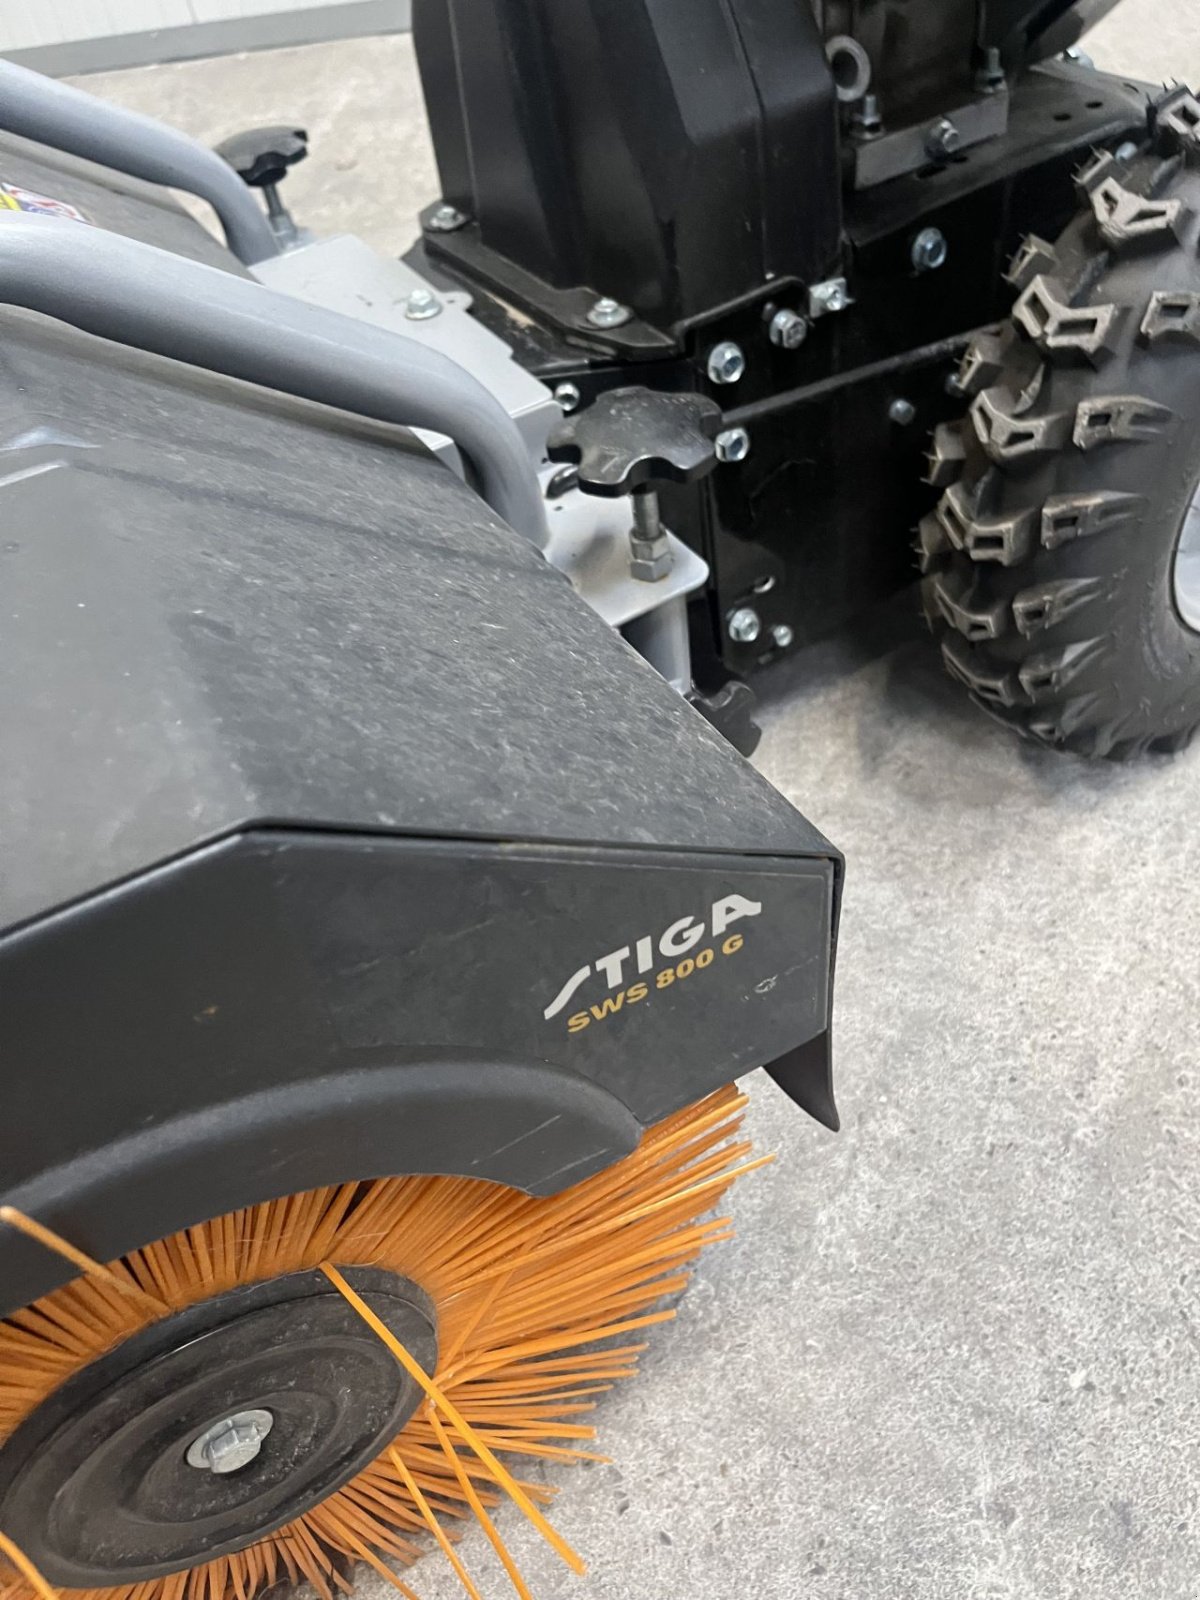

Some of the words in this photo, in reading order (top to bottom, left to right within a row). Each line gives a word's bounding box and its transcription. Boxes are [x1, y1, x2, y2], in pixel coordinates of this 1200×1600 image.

[543, 893, 762, 1020] STIGA
[567, 982, 649, 1032] SWS
[656, 948, 715, 989] 800
[722, 934, 743, 955] G
